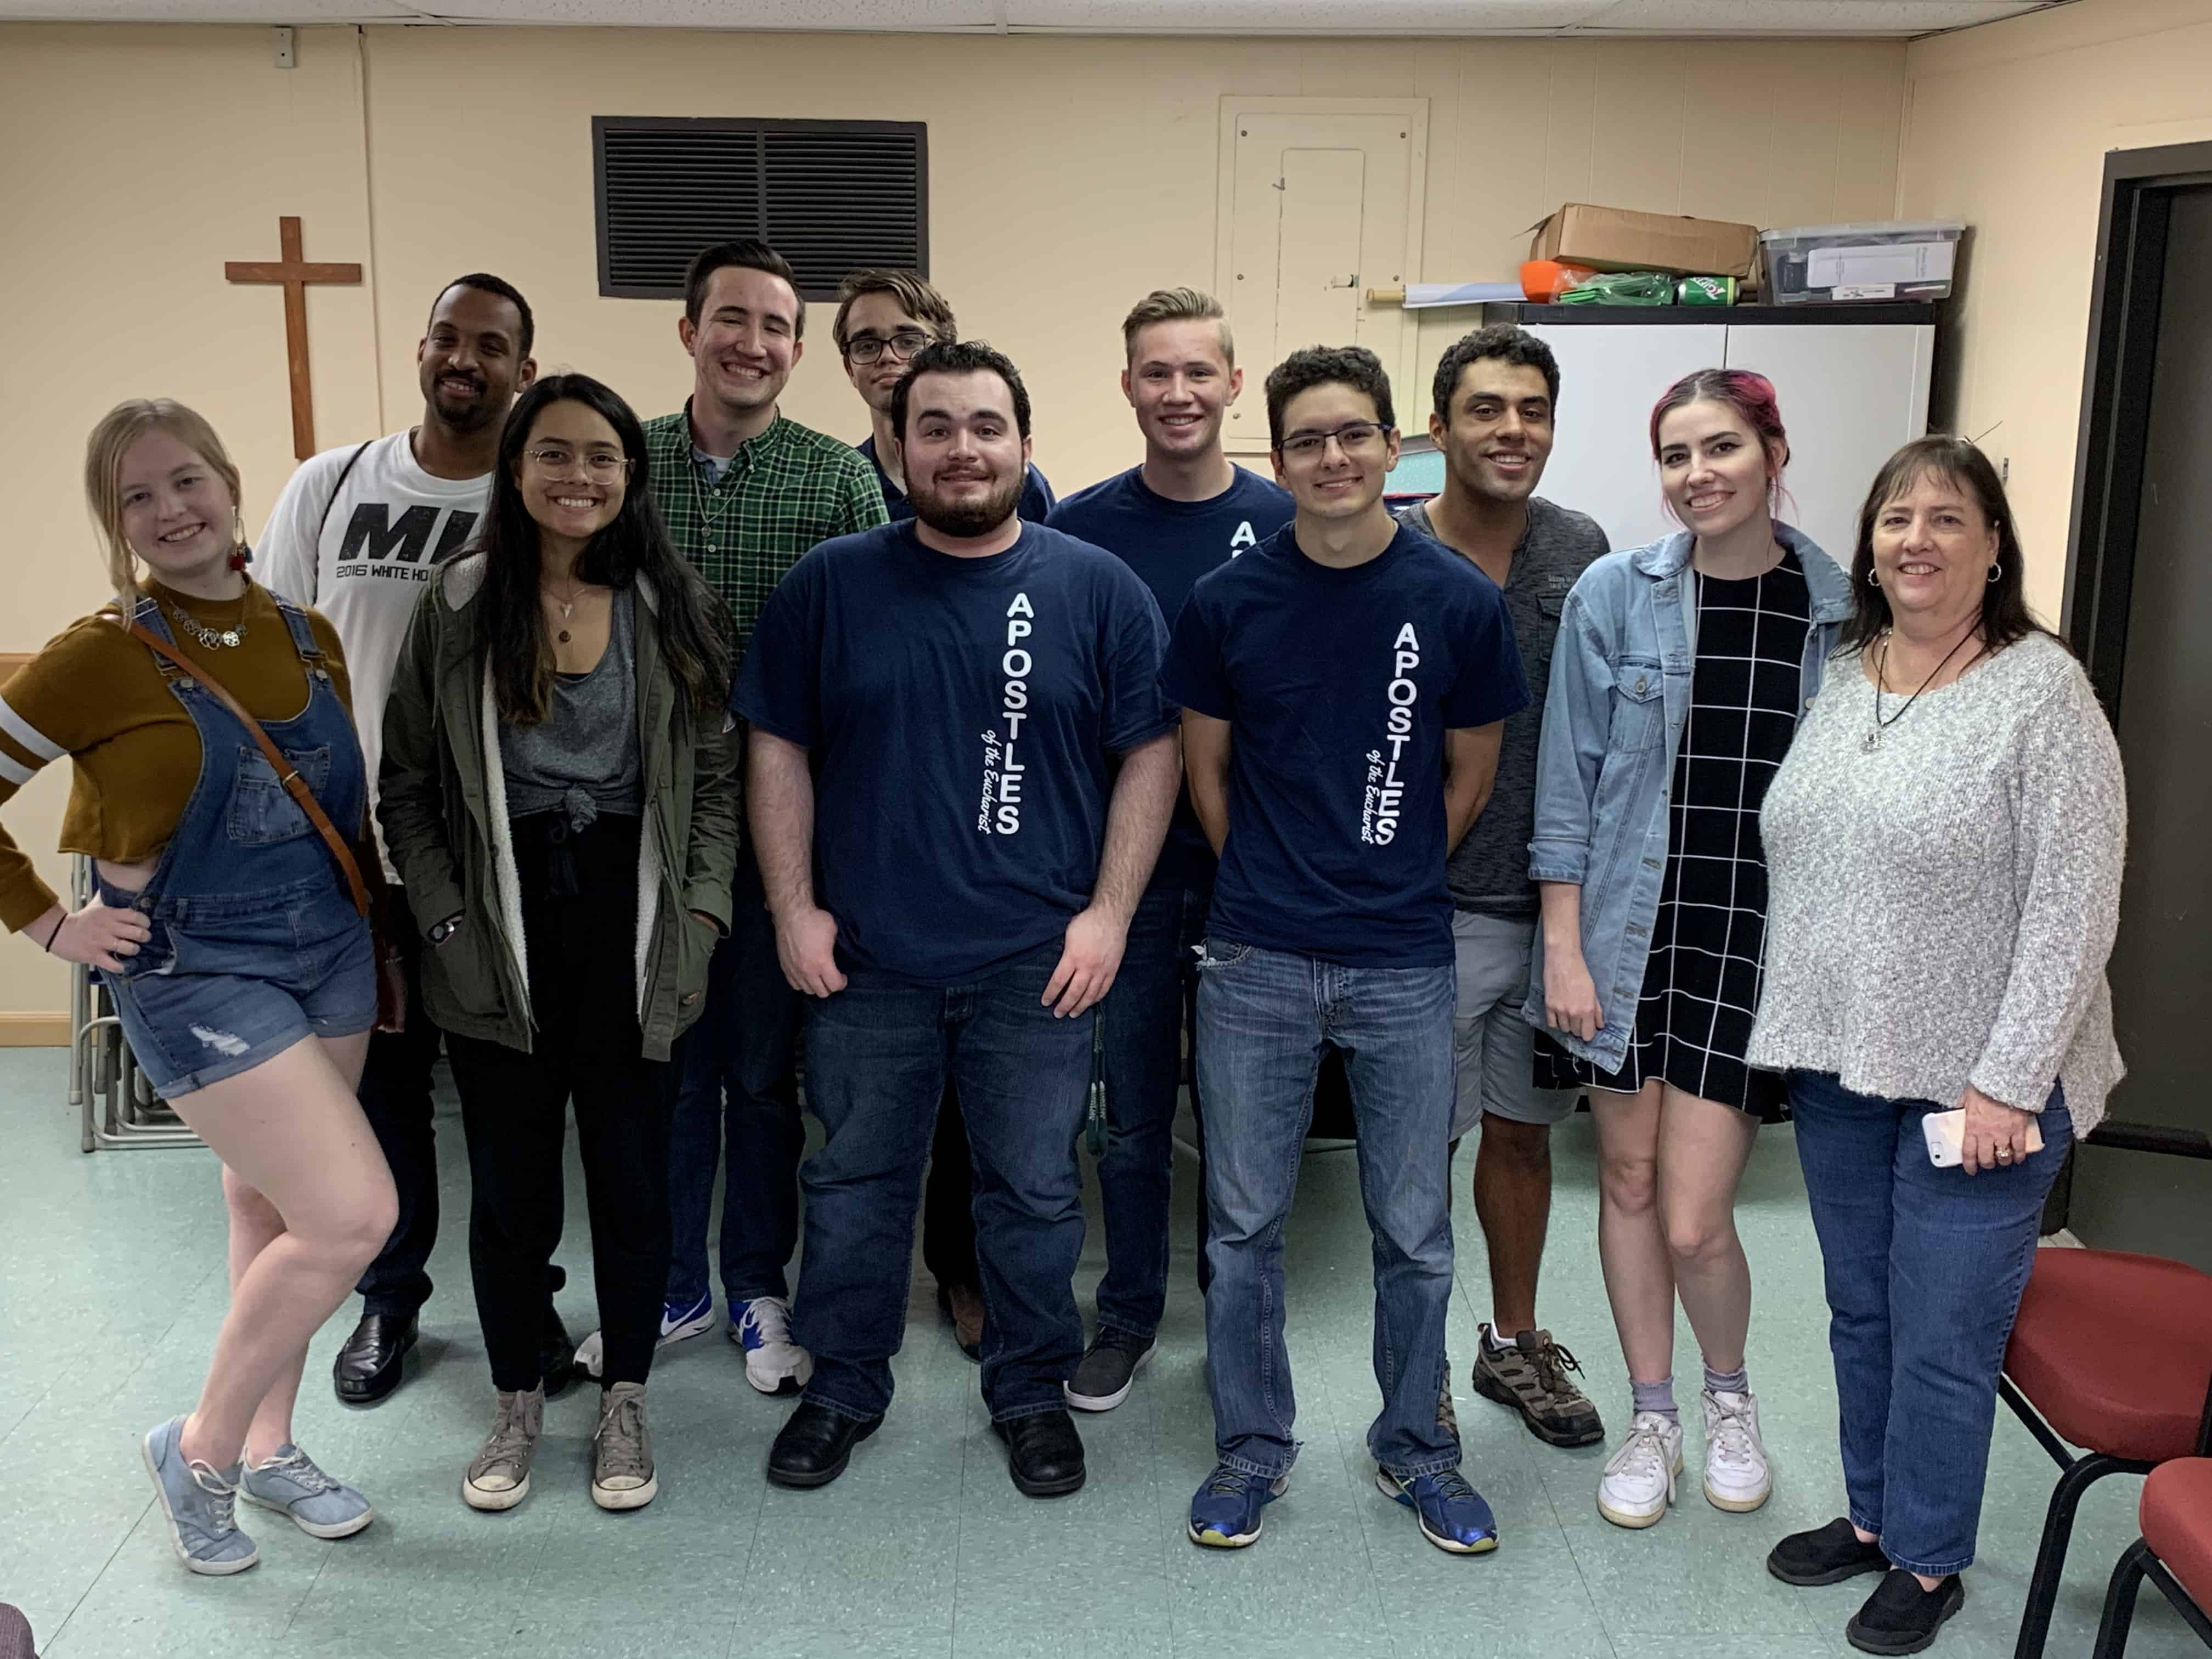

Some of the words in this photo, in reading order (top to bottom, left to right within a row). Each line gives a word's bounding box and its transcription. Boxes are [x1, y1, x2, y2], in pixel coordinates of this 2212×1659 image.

[1230, 521, 1257, 558] A
[336, 565, 368, 578] 2016
[371, 565, 410, 580] WHITE
[996, 592, 1034, 835] APOSTLES
[981, 729, 1002, 747] of
[1375, 622, 1420, 845] APOSTLES
[985, 747, 1001, 767] the
[1366, 749, 1386, 765] of
[1368, 765, 1383, 783] the
[977, 769, 999, 834] Eucharist
[1361, 785, 1380, 844] Eucharist
